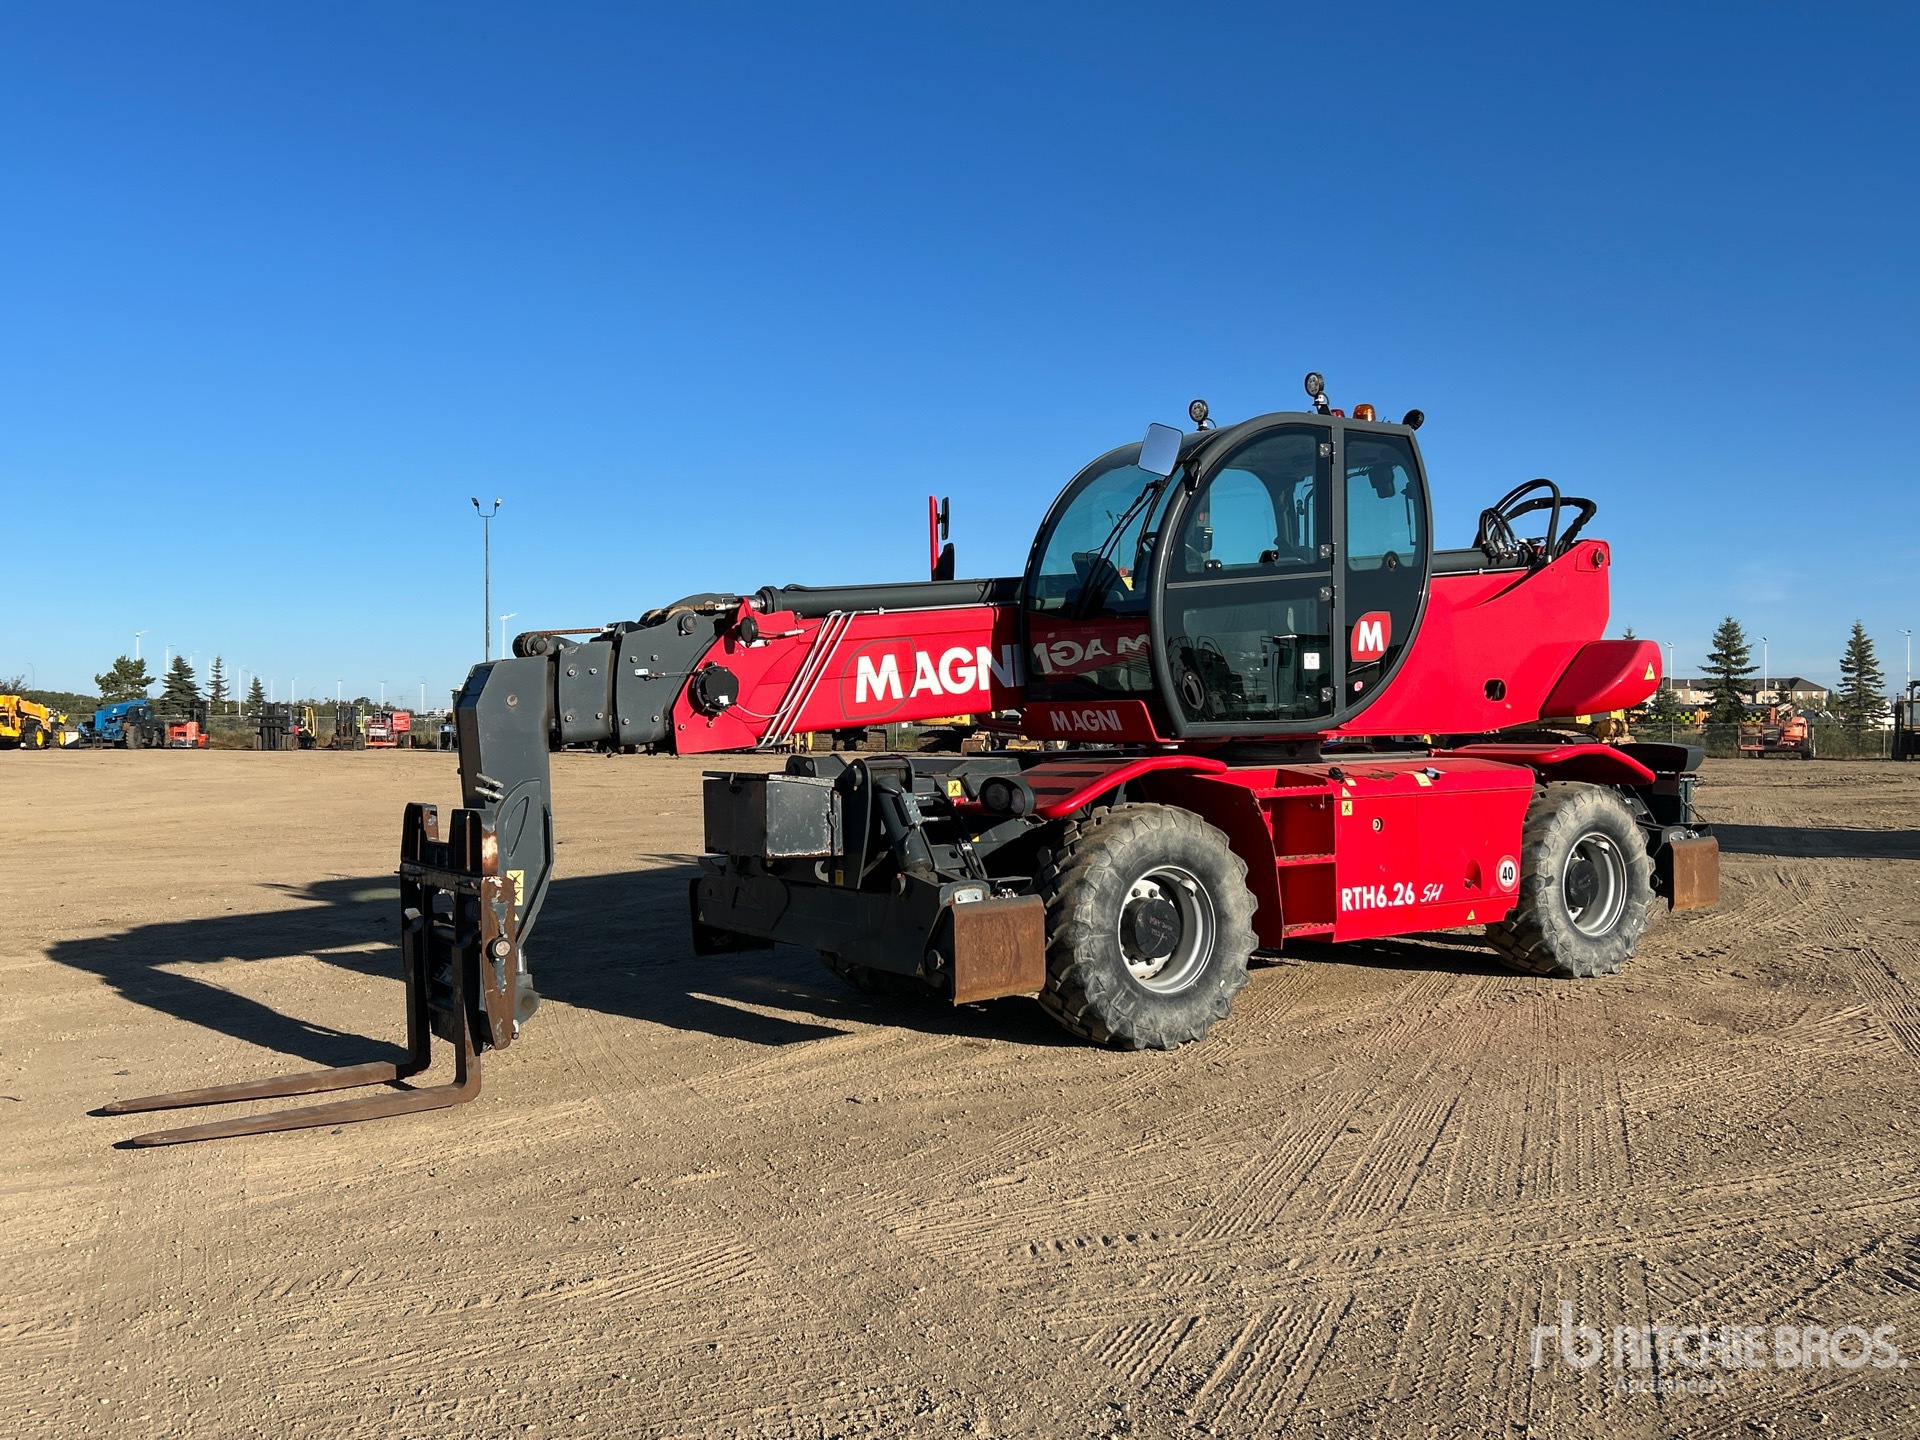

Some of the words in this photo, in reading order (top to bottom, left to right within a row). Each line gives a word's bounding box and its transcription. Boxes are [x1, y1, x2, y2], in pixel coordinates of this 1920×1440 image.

[1357, 620, 1384, 652] M
[855, 643, 1025, 703] MAGNI
[1050, 709, 1123, 731] MAGNI
[1502, 866, 1514, 881] 40
[1341, 881, 1416, 911] RTH6.26
[1420, 883, 1444, 903] SH
